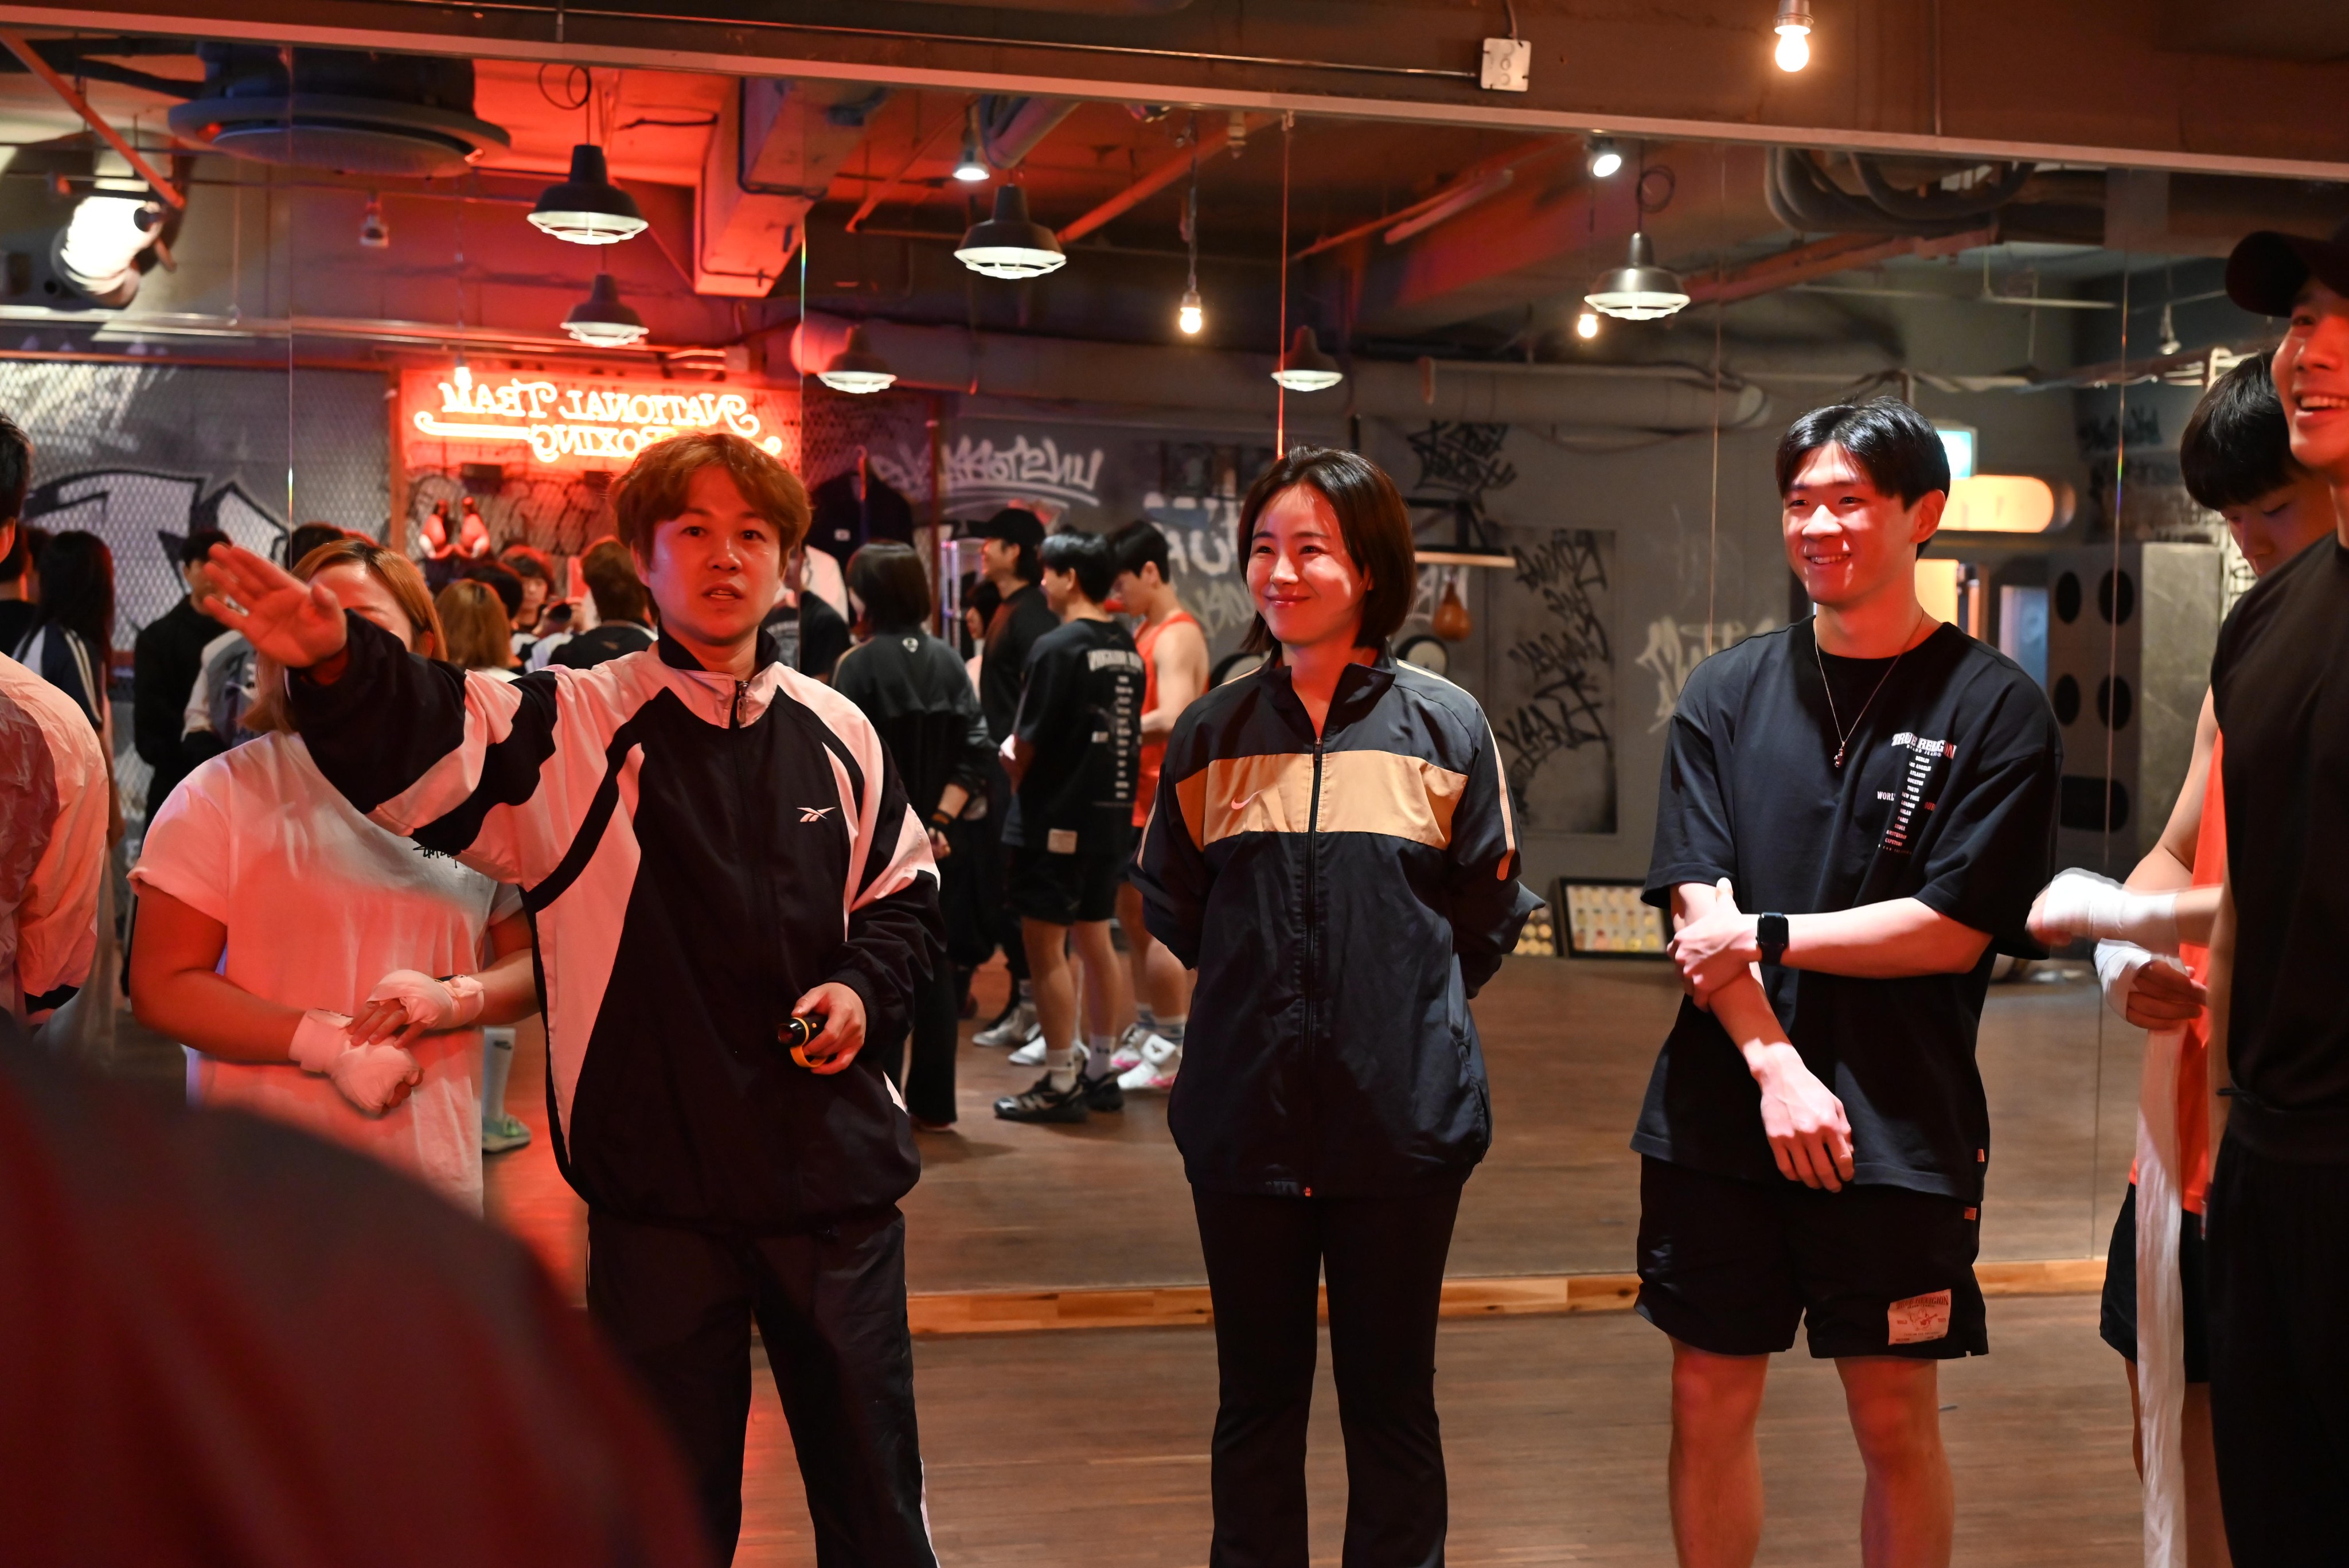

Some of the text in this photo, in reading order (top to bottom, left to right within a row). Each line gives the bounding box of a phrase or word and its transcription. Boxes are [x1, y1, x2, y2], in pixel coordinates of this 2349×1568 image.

[1891, 732, 1918, 747] TRUE
[1877, 791, 1895, 801] WORL
[1915, 1295, 1949, 1306] RELIGION
